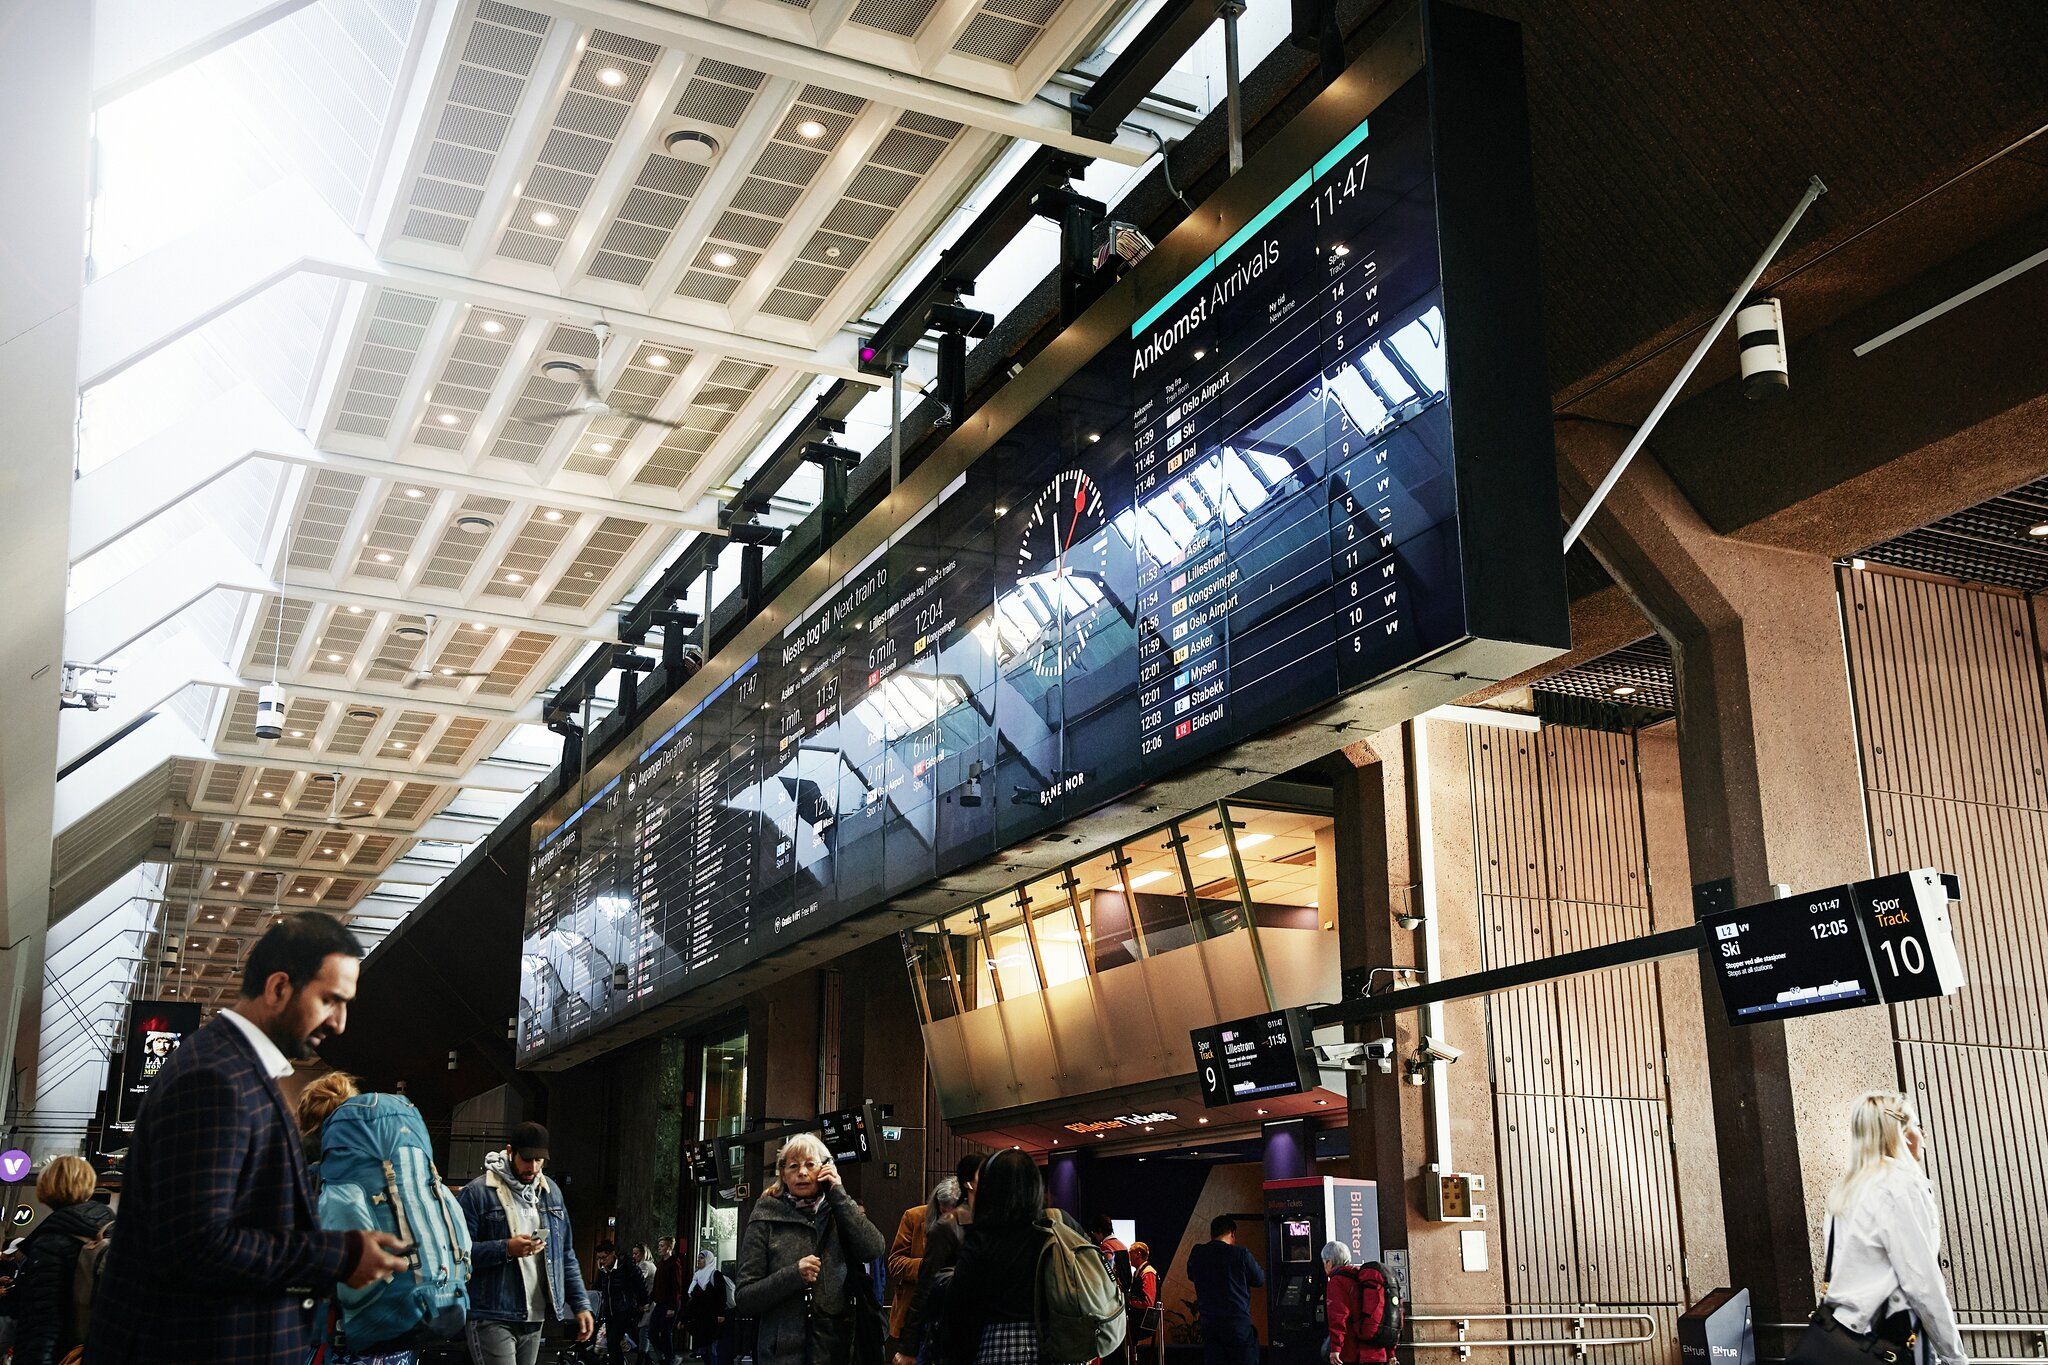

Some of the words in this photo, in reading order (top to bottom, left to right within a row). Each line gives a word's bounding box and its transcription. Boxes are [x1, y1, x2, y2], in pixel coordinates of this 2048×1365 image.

[1311, 154, 1369, 225] 11:47
[1330, 259, 1346, 276] Track
[1133, 297, 1207, 378] Ankomst
[1211, 240, 1279, 313] Arrivals
[1270, 310, 1282, 324] New
[1134, 428, 1154, 453] 11:39
[1182, 396, 1200, 416] Oslo
[1201, 371, 1230, 402] Airport
[1333, 282, 1344, 301] 14
[1135, 450, 1155, 474] 11:45
[1183, 420, 1195, 439] Ski
[1336, 310, 1343, 325] 8
[1136, 473, 1156, 496] 11:46
[1184, 442, 1196, 462] Dal
[1337, 335, 1344, 351] 5
[1341, 415, 1348, 431] 2
[1138, 567, 1158, 588] 11:53
[1342, 442, 1349, 457] 9
[1139, 591, 1159, 612] 11:54
[1187, 551, 1228, 583] Lillestrøm
[1344, 469, 1351, 486] 7
[1139, 614, 1160, 636] 11:56
[1189, 569, 1239, 606] Kongsvinger
[1346, 496, 1353, 512] 5
[1140, 637, 1160, 658] 11:59
[1190, 613, 1208, 631] Oslo
[1209, 593, 1238, 620] Airport
[1348, 524, 1354, 540] 2
[783, 636, 806, 667] Neste
[807, 622, 820, 647] tog
[821, 609, 830, 634] til
[833, 592, 854, 625] Next
[855, 577, 876, 607] train
[877, 568, 888, 588] to
[915, 597, 943, 635] 12:04
[1141, 661, 1160, 683] 12:01
[1191, 635, 1213, 655] Asker
[1347, 550, 1358, 568] 11
[869, 648, 876, 669] 6
[876, 637, 897, 664] min.
[1141, 686, 1160, 708] 12:01
[1191, 659, 1217, 682] Mysen
[1351, 581, 1358, 596] 8
[1141, 710, 1161, 731] 12:03
[1192, 678, 1225, 706] Stabekk
[1349, 607, 1362, 625] 10
[738, 673, 758, 703] 11:47
[781, 682, 796, 702] Asker
[817, 676, 839, 707] 11:57
[1142, 734, 1162, 755] 12:06
[1192, 703, 1224, 731] Eidsvoll
[1354, 636, 1361, 652] 5
[780, 716, 786, 734] 1
[786, 708, 803, 731] min.
[913, 735, 920, 758] 6
[867, 765, 873, 786] 2
[1040, 782, 1062, 806] BANE
[1065, 772, 1084, 792] NOR
[1818, 898, 1840, 912] 11:47
[1872, 898, 1899, 914] Spor
[1875, 909, 1910, 927] Track
[1810, 918, 1848, 940] 12:05
[1720, 940, 1741, 957] Ski
[1880, 936, 1925, 977] 10
[1197, 1041, 1210, 1053] Spor
[1271, 1018, 1283, 1028] 11:47
[1199, 1050, 1215, 1061] Track
[1224, 1041, 1255, 1055] Lillestrøm
[1267, 1033, 1287, 1047] 11:56
[1206, 1066, 1217, 1093] 9
[859, 1133, 867, 1152] 8
[1350, 1191, 1363, 1256] Billetter
[1682, 1344, 1706, 1357] ENTUR
[1712, 1345, 1738, 1358] ENTUR
